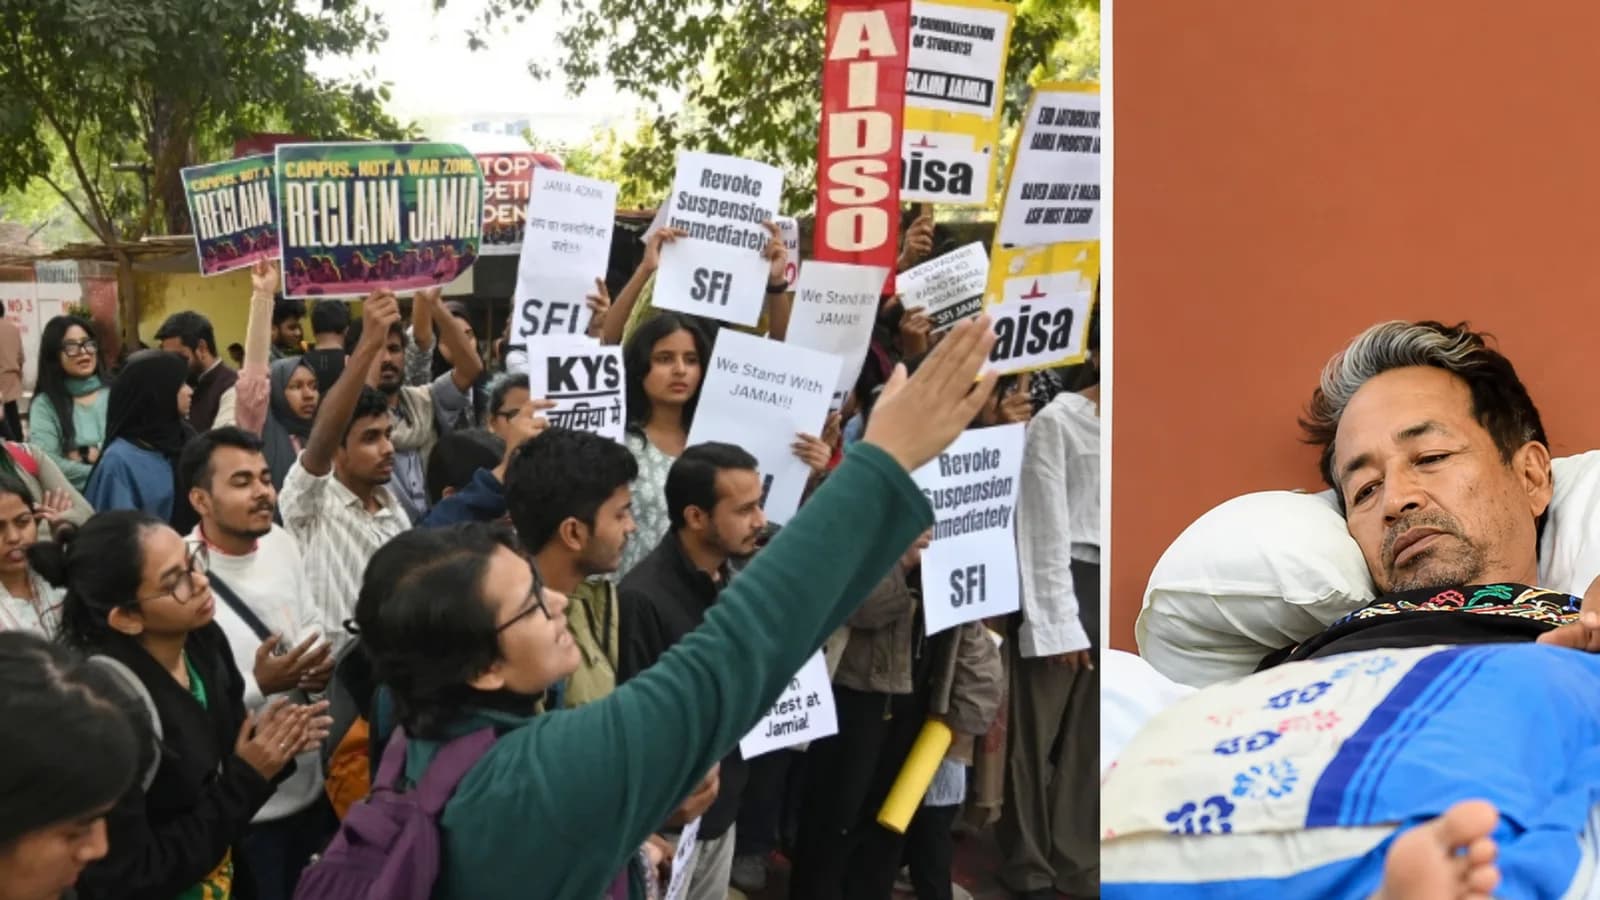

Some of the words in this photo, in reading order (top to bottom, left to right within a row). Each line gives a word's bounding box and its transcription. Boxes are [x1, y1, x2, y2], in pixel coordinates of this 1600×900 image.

[913, 34, 925, 48] OF
[947, 77, 987, 102] JAMIA
[827, 9, 898, 252] AIDSO
[285, 160, 355, 179] CAMPUS.
[358, 159, 388, 176] NOT
[393, 160, 405, 177] A
[408, 158, 440, 176] WAR
[443, 157, 477, 175] ZONE
[699, 167, 763, 198] Revoke
[901, 151, 973, 195] isa
[194, 180, 273, 241] RECLAIM
[285, 178, 401, 248] RECLAIM
[408, 176, 481, 243] JAMIA
[676, 190, 773, 225] Suspension
[689, 267, 733, 307] SFI
[800, 289, 822, 303] We
[518, 298, 581, 337] SFI
[989, 304, 1074, 363] aisa
[546, 354, 620, 393] KYS
[716, 356, 739, 374] We
[741, 362, 787, 385] Stand
[789, 373, 823, 394] With
[728, 383, 793, 410] JAMIA!!!
[938, 447, 1001, 478] Revoke
[949, 563, 986, 608] SFI
[806, 690, 821, 708] at
[765, 711, 810, 738] Jamia!
